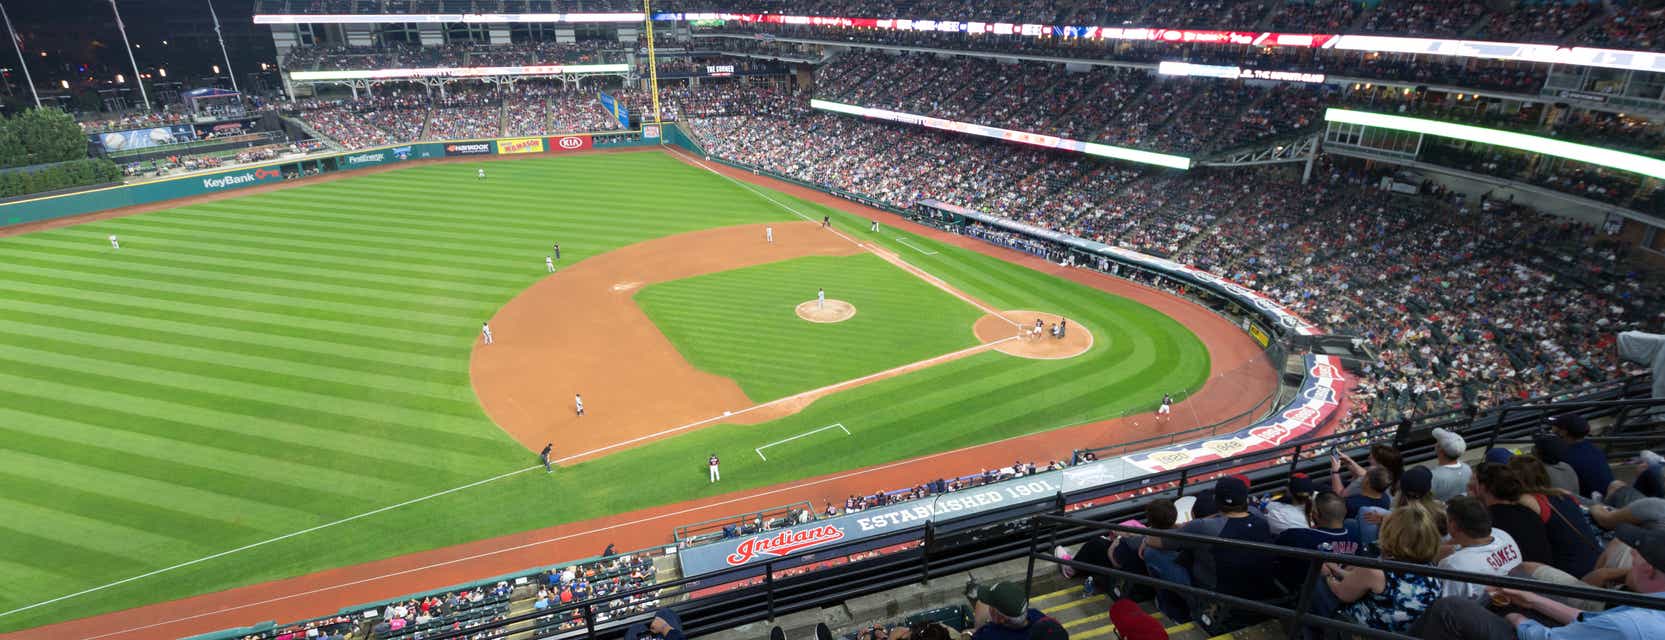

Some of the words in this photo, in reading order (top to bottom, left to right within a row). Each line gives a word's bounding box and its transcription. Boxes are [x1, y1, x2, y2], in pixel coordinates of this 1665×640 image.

[203, 173, 255, 190] KeyBank
[857, 490, 1003, 531] ESTABLISHED
[726, 523, 845, 566] Indians
[1486, 544, 1518, 570] GOMES
